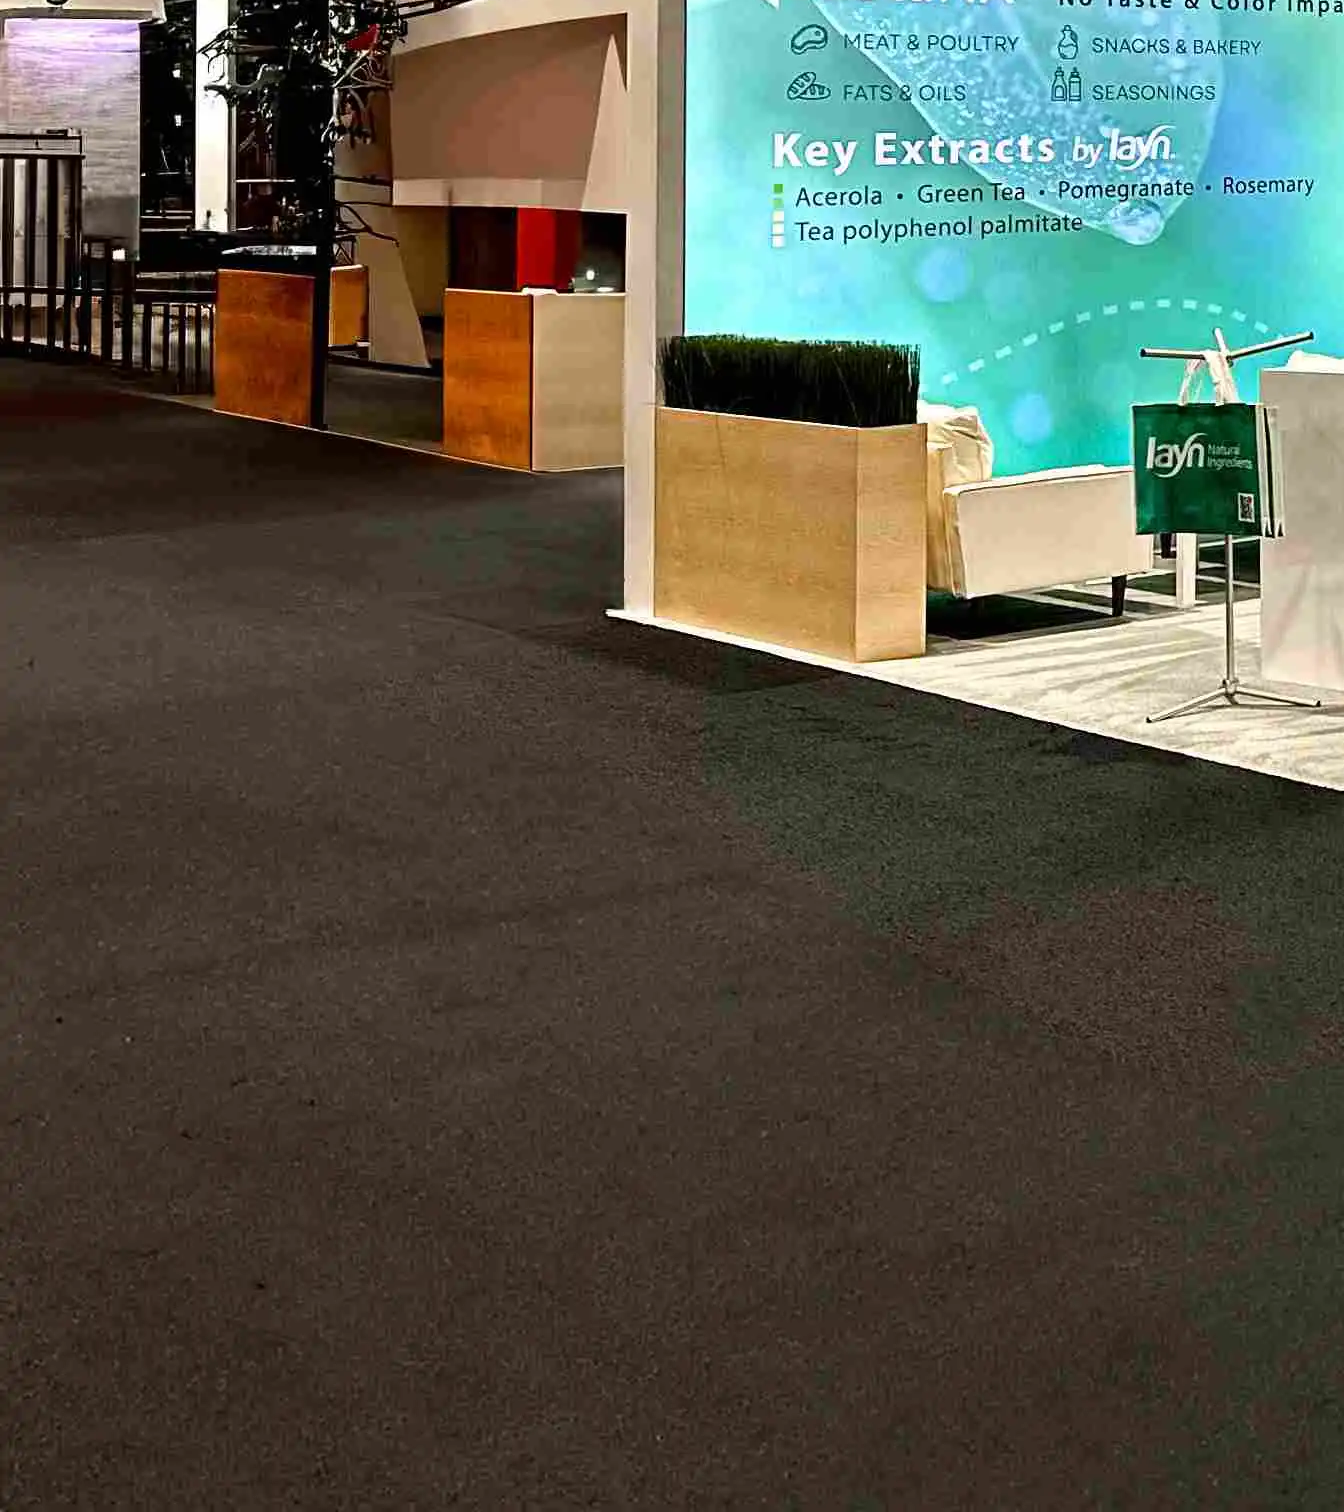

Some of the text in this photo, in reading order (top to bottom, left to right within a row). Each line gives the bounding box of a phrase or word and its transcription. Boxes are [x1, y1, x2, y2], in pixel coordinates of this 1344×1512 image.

[844, 34, 1019, 52] MEAT & POULTRY
[1092, 39, 1261, 56] SNACKS & BAKERY
[844, 84, 967, 101] FATS & OILS
[1092, 85, 1216, 101] SEASONINGS
[773, 133, 857, 175] Key
[874, 133, 1056, 168] Extracts
[1072, 137, 1103, 169] by
[795, 176, 1314, 208] Acerola Green Tea Pomegranate Rosemary
[796, 213, 1083, 246] Tea polyphenol palmitate
[1147, 432, 1208, 478] layn
